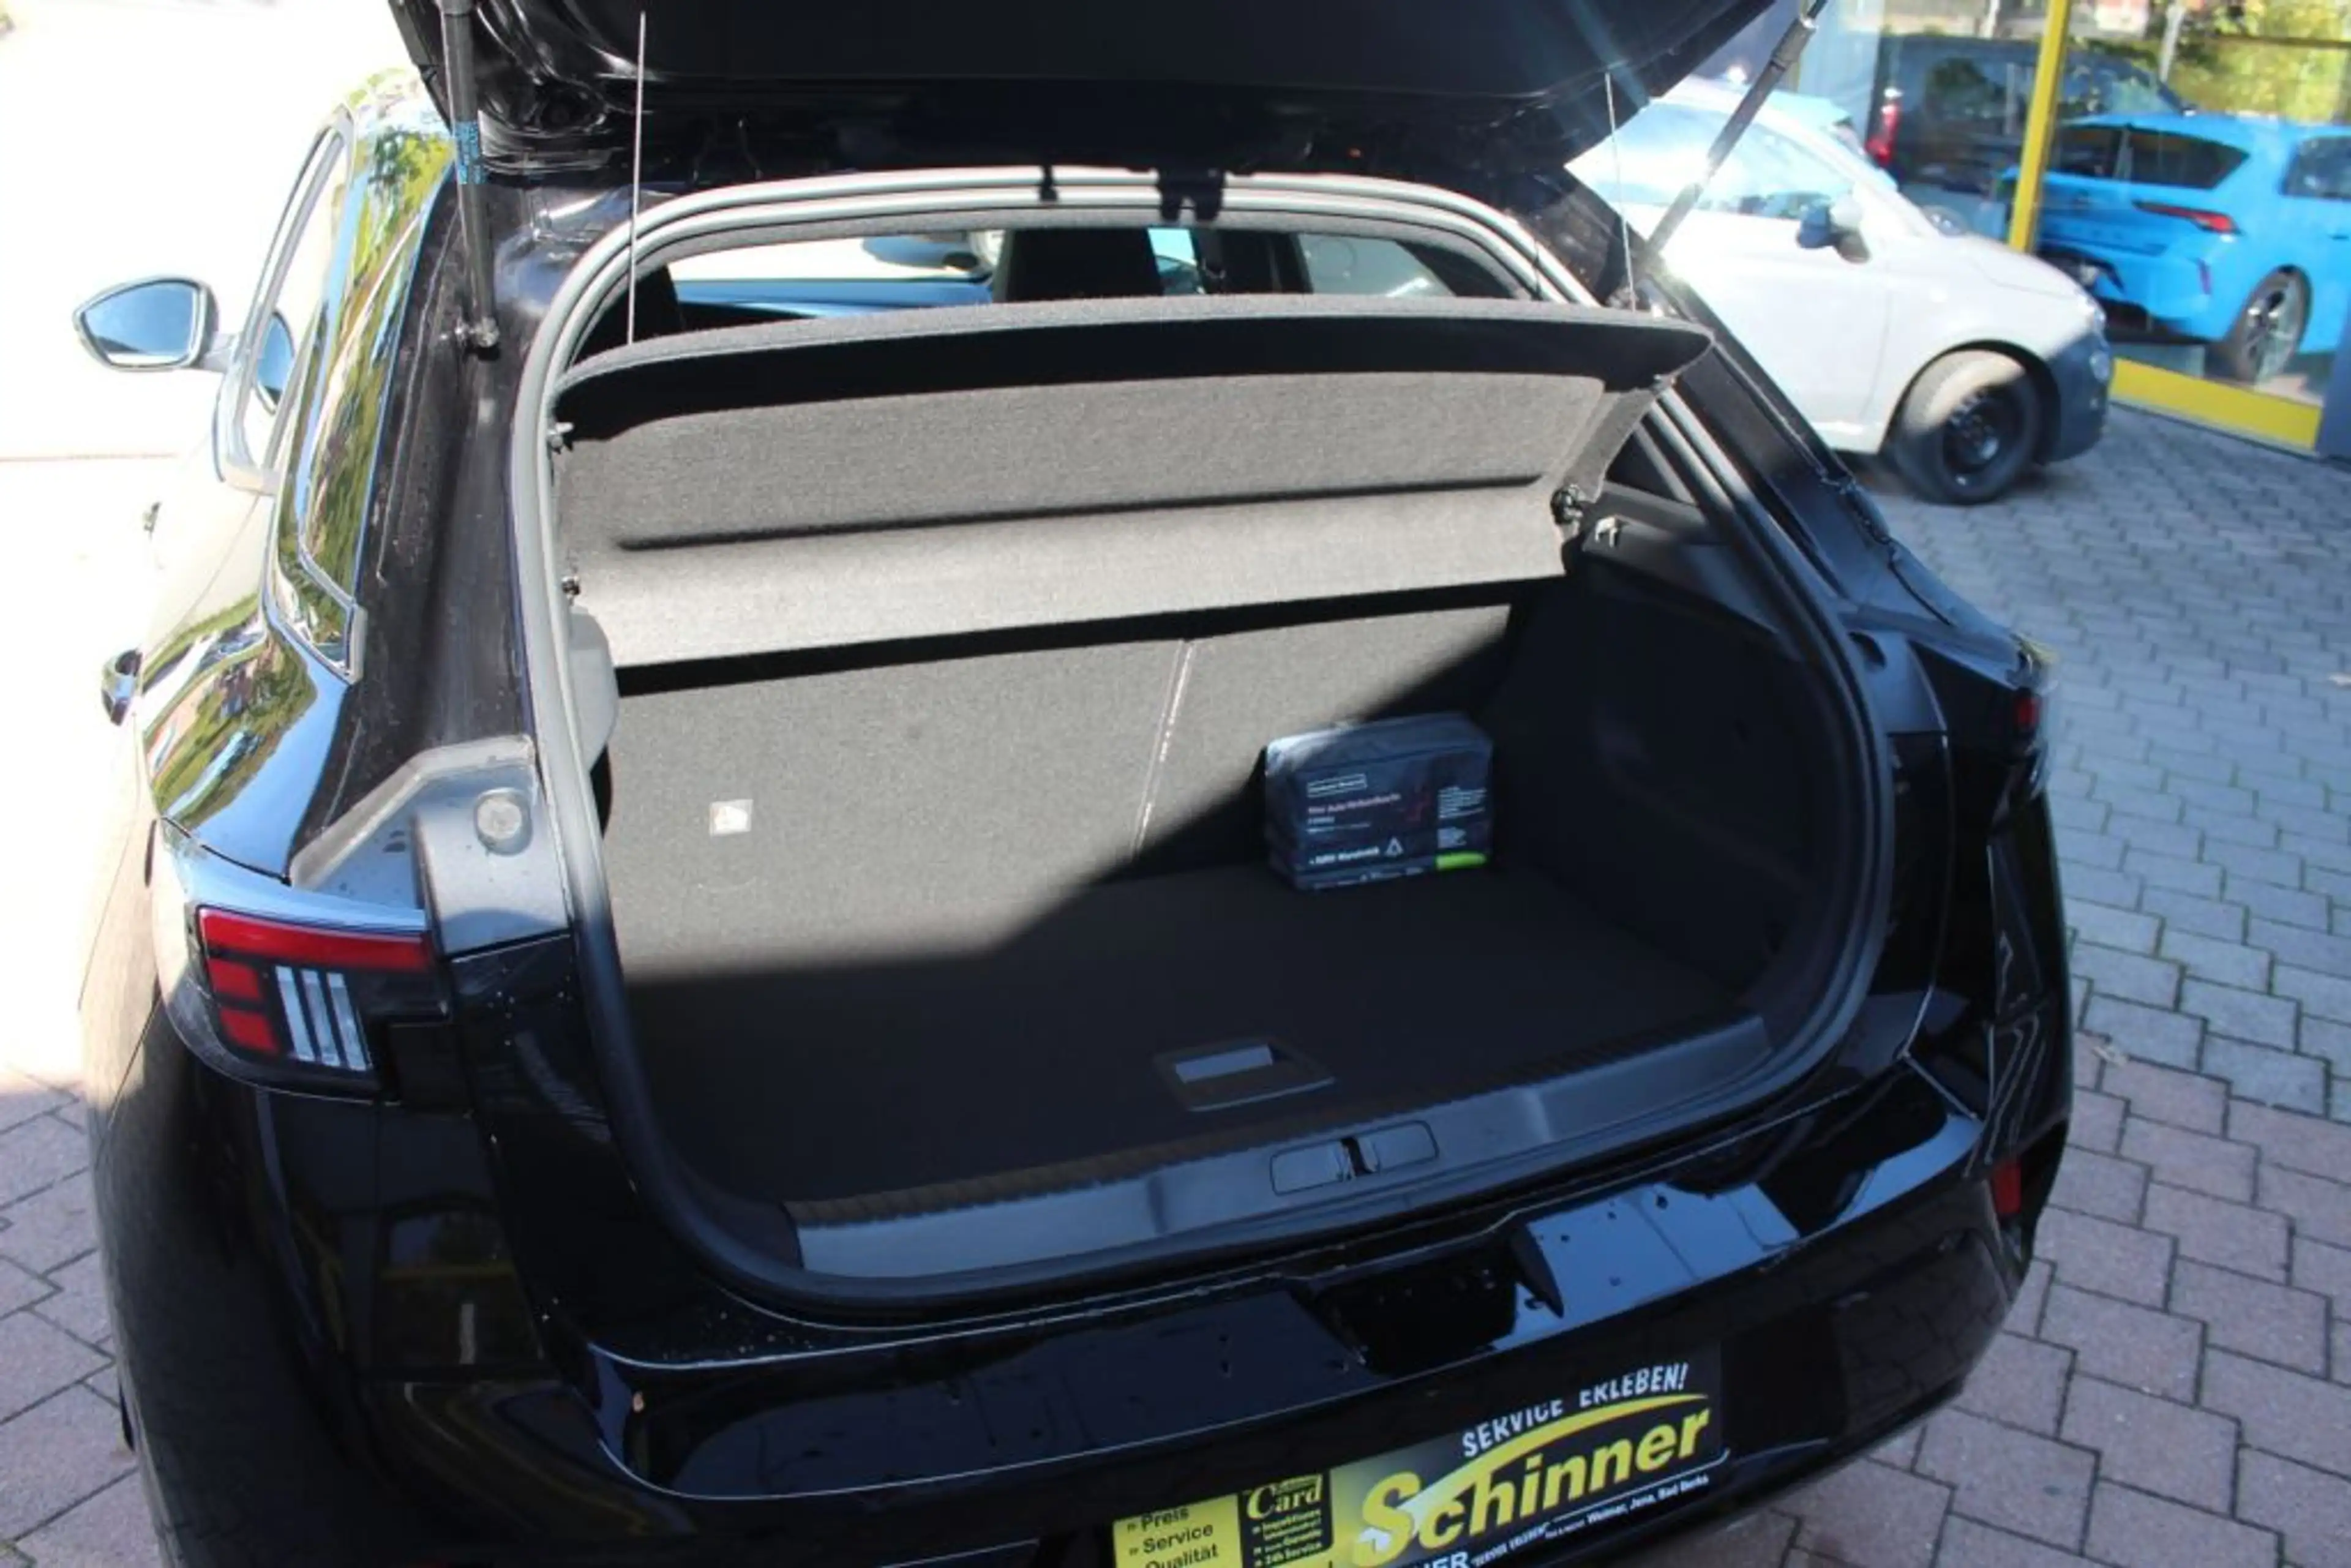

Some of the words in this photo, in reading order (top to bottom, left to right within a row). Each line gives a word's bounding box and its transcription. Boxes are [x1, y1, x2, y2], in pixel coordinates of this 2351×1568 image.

[1461, 1399, 1563, 1457] SERVICE
[1579, 1363, 1689, 1408] ERLEBEN!
[1247, 1474, 1322, 1520] Card
[1352, 1408, 1709, 1567] Schinner
[1141, 1507, 1190, 1530] Preis
[1142, 1523, 1214, 1554] Service
